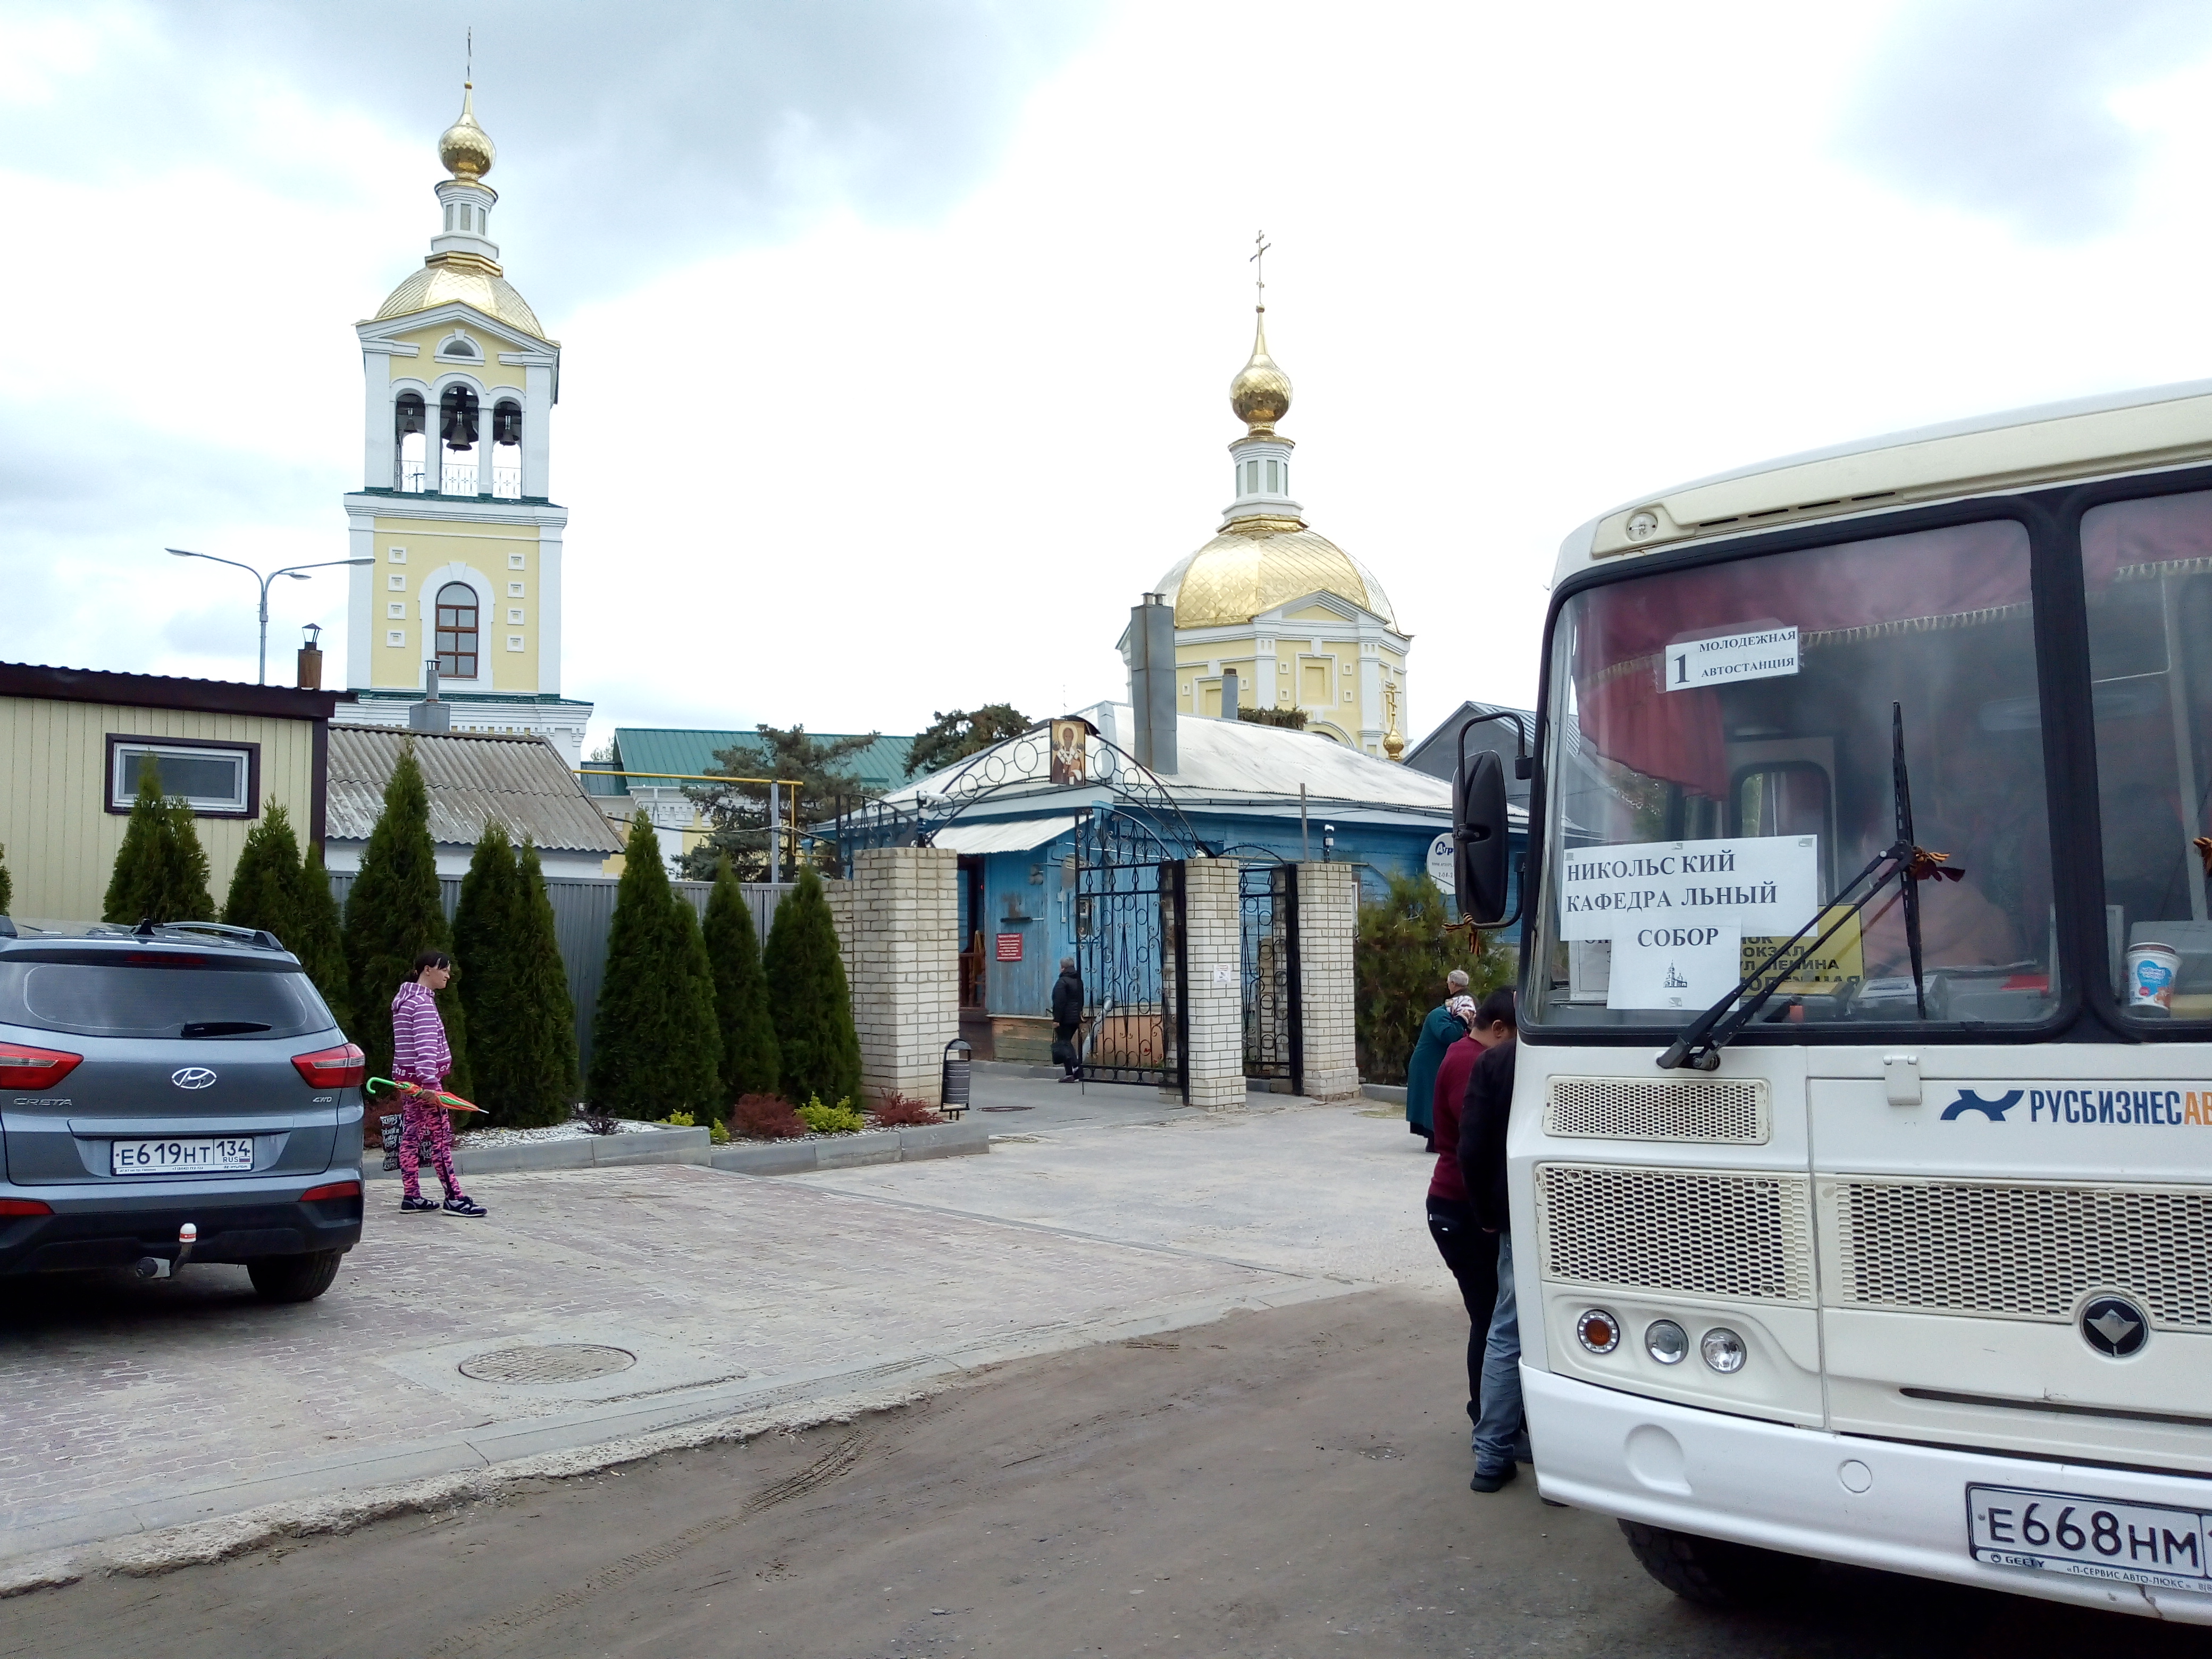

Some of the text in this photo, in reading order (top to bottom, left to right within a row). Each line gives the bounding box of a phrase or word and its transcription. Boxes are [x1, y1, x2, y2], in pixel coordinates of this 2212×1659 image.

[1699, 631, 1796, 652] МОЛОДЕЖНАЯ
[1674, 653, 1690, 684] 1
[1702, 657, 1795, 677] АВТОСТАНЦИЯ
[1637, 928, 1719, 947] СОБОР
[13, 1097, 72, 1106] CRETA
[216, 1140, 248, 1157] 134
